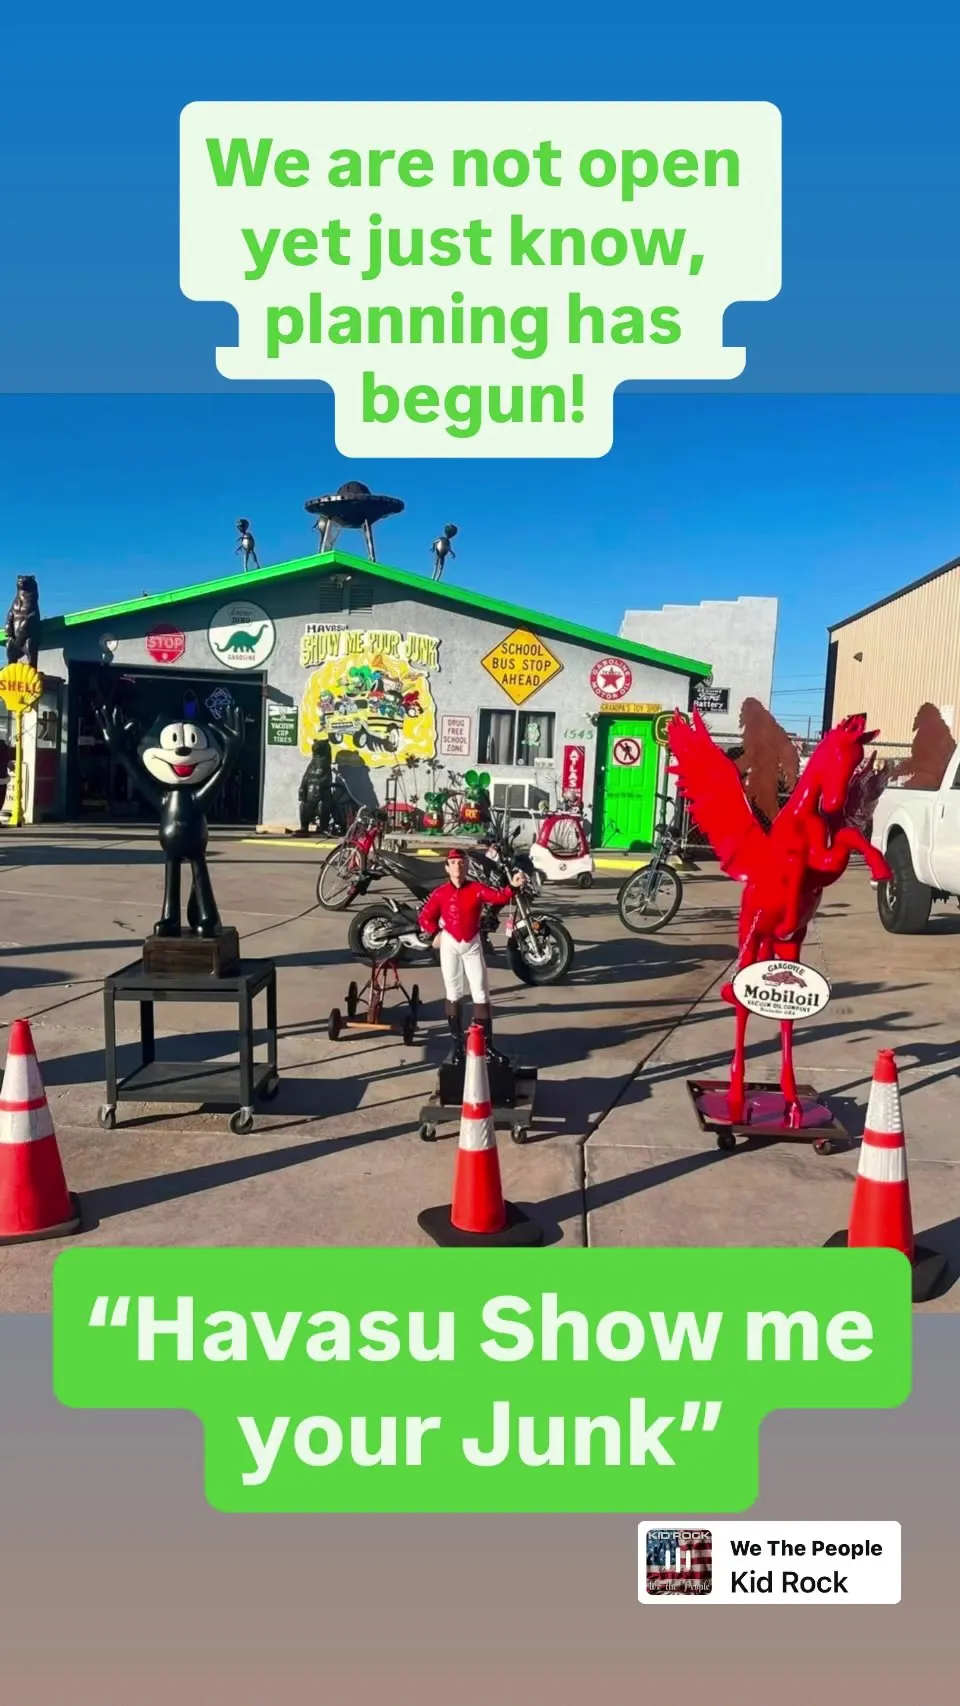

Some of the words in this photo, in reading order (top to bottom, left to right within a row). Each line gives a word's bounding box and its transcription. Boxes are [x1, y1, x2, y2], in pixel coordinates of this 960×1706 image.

[148, 636, 183, 649] STOP
[303, 633, 340, 666] SHOW
[347, 632, 365, 655] ME
[369, 632, 401, 659] YOUR
[406, 635, 439, 671] JUNK
[501, 643, 544, 656] SCHOOL
[492, 657, 515, 670] BUS
[522, 659, 552, 672] STOP
[592, 659, 631, 675] GASOLINE
[0, 680, 37, 693] SHELL
[501, 673, 540, 687] AHEAD
[592, 681, 618, 699] MOTOR
[694, 700, 724, 709] Battery
[447, 719, 465, 727] DRUG
[443, 736, 467, 744] SCHOOL
[564, 729, 593, 739] 1545
[447, 744, 464, 752] ZONE
[568, 749, 580, 788] ATLAS
[768, 963, 806, 975] GARGOYLE
[744, 985, 820, 1007] Mobiloil
[748, 1000, 771, 1008] VACUUM
[783, 1004, 811, 1013] COMPANY
